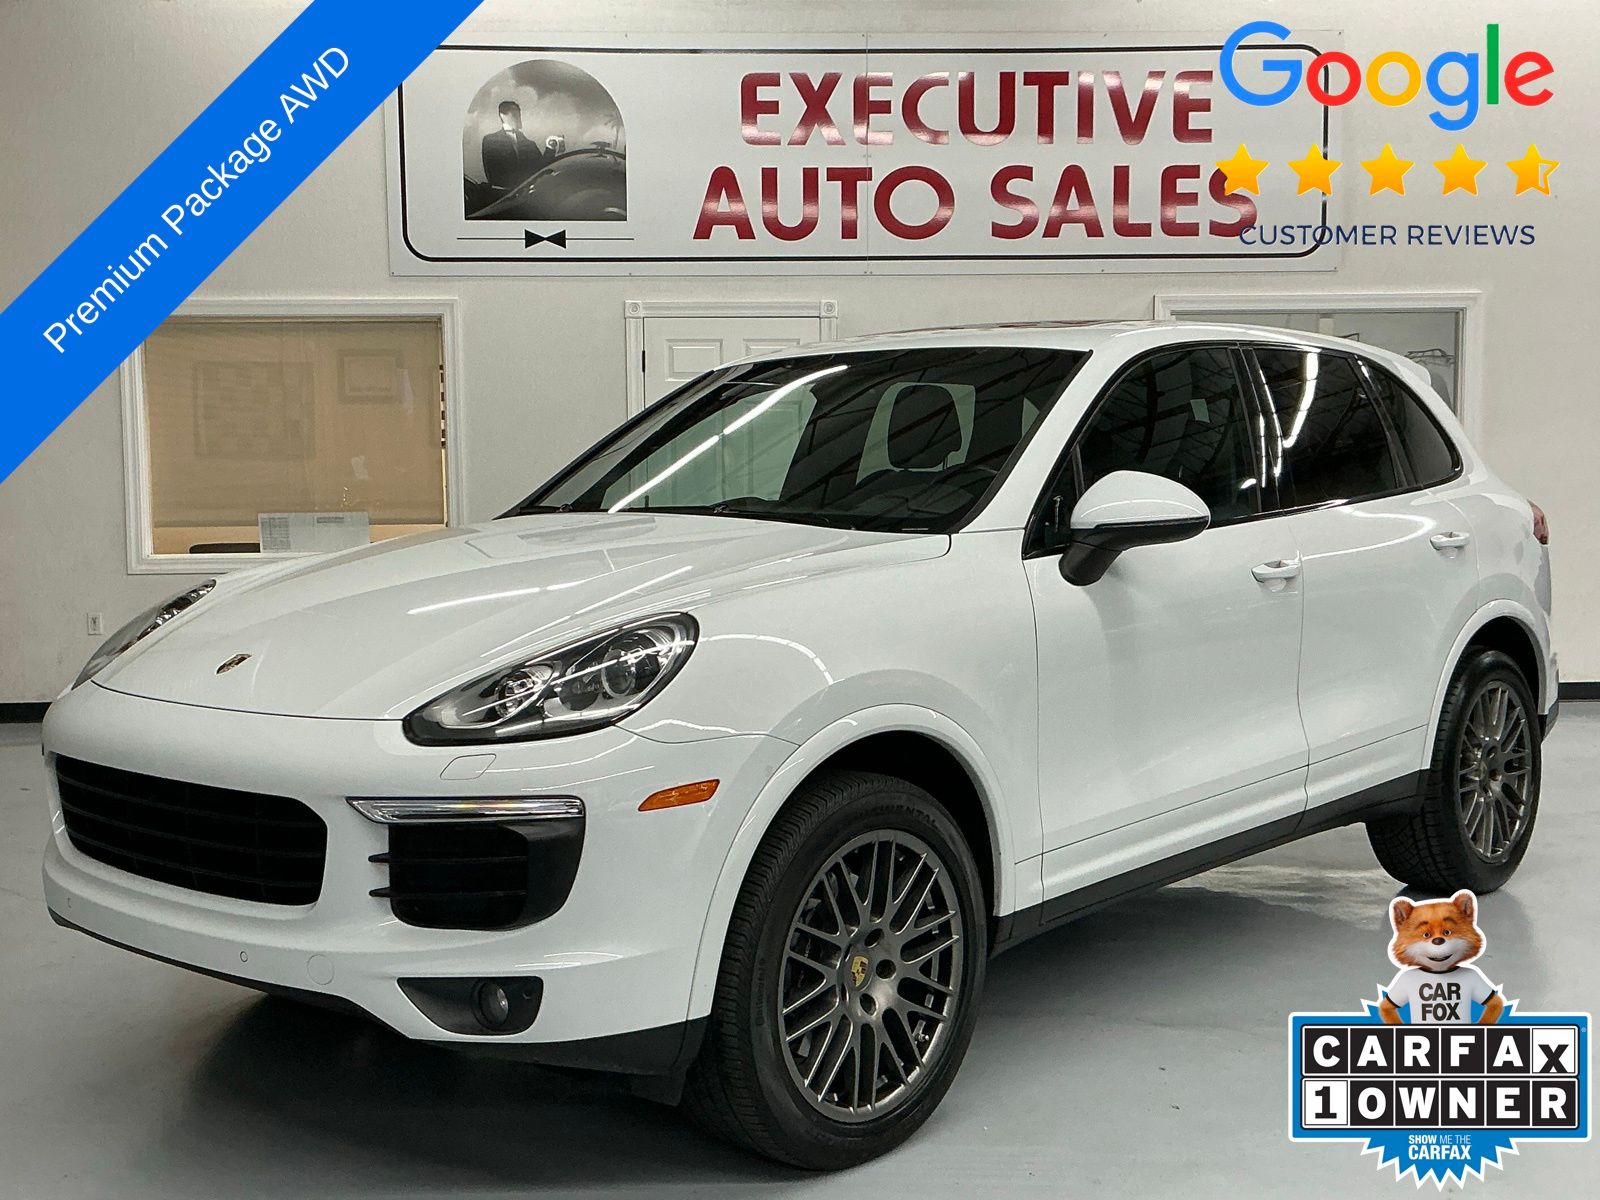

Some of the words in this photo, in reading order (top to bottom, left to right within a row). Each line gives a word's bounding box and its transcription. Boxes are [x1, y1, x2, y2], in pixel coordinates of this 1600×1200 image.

[740, 70, 1214, 146] EXECUTIVE
[692, 164, 955, 241] AUTO
[990, 164, 1258, 239] SALES
